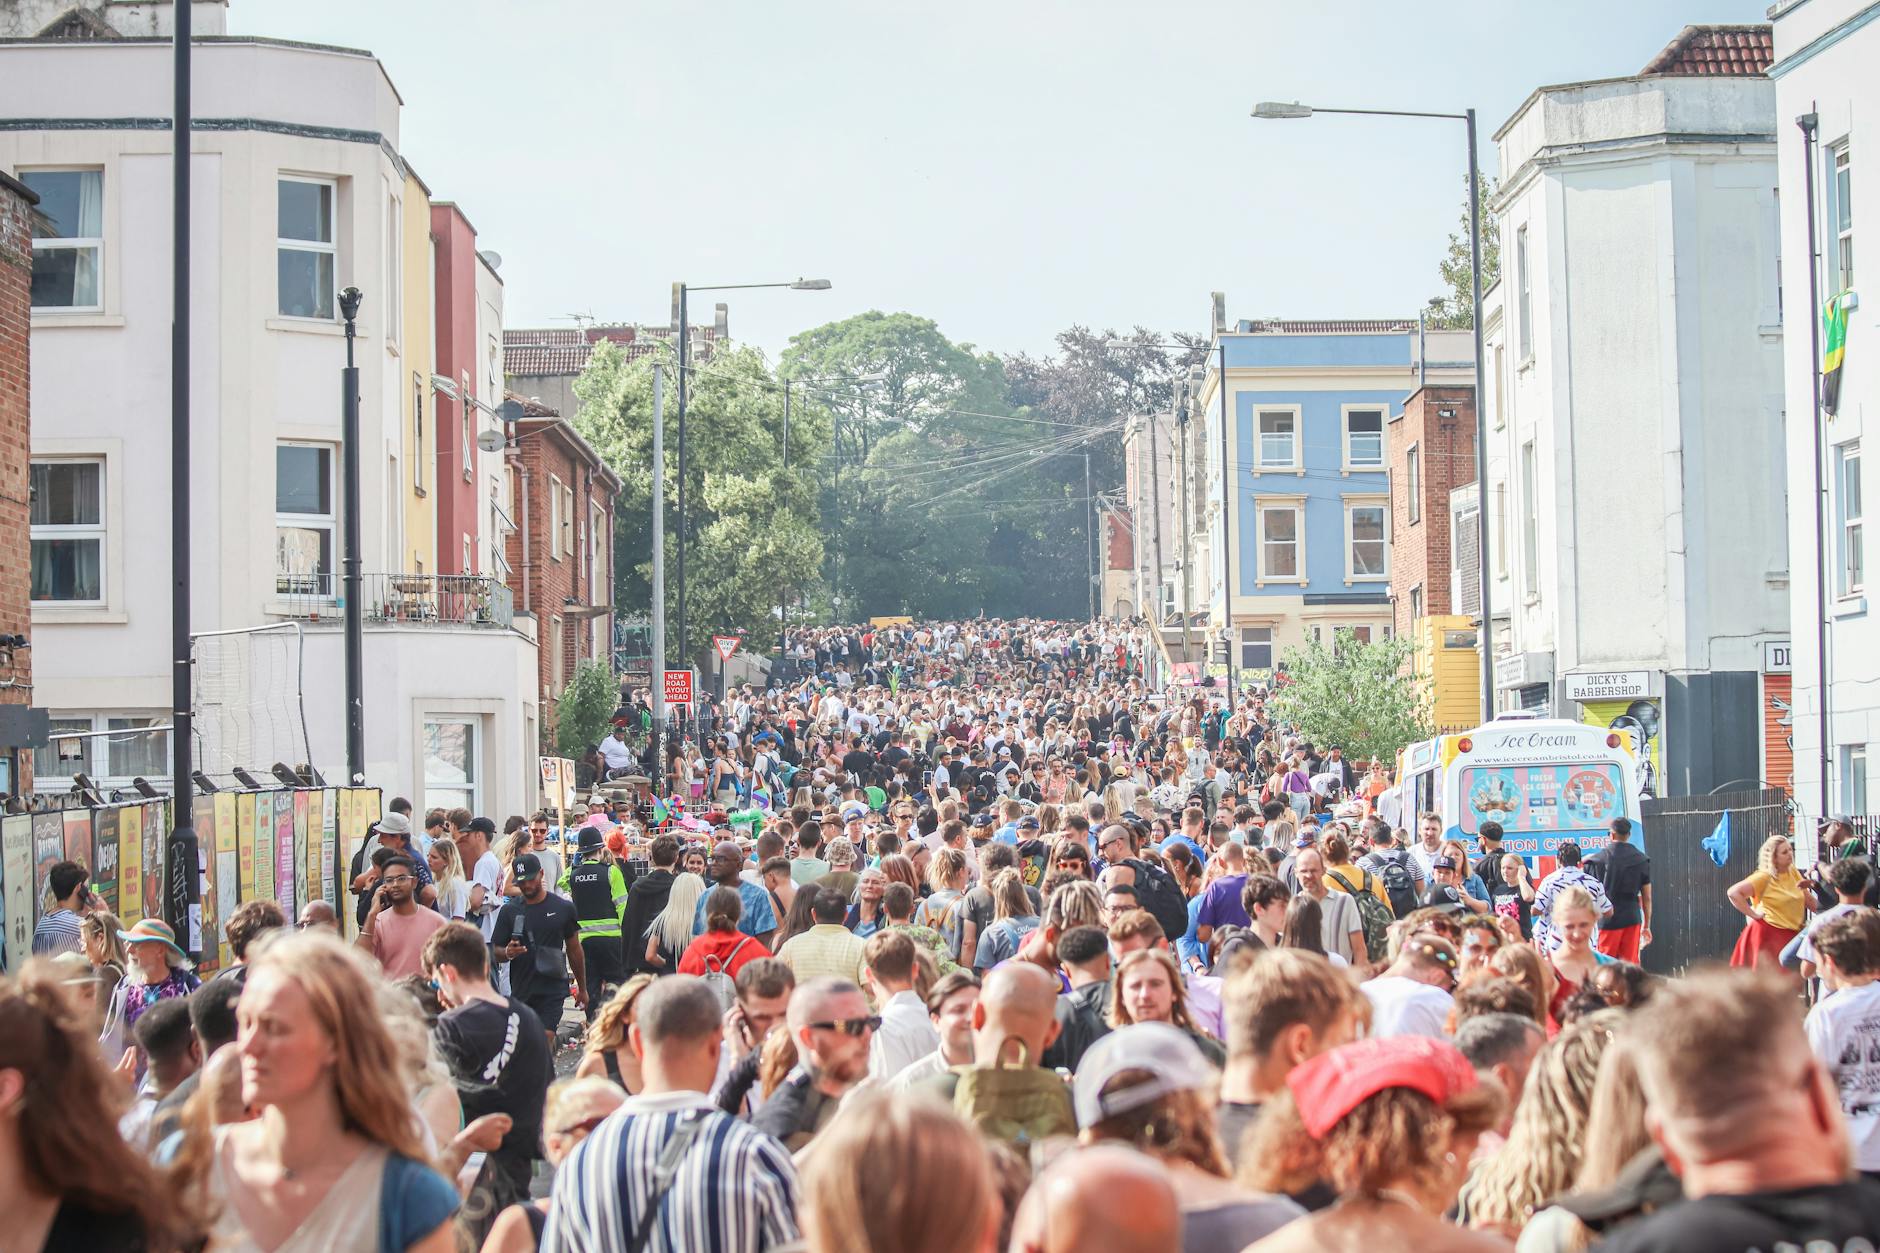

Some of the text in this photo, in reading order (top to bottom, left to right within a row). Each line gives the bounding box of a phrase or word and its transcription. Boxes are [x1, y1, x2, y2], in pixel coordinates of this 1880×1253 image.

[1774, 648, 1791, 665] DI
[1587, 674, 1627, 685] DICKY'S
[1574, 685, 1641, 697] BARBERSHOP
[1494, 732, 1577, 748] Ice Cream
[1474, 753, 1608, 763] www.icecreambristol.co.uk
[1530, 774, 1553, 782] FRESH
[1536, 783, 1561, 791] CREAM
[1466, 839, 1538, 854] CTION
[575, 874, 598, 883] POLICE
